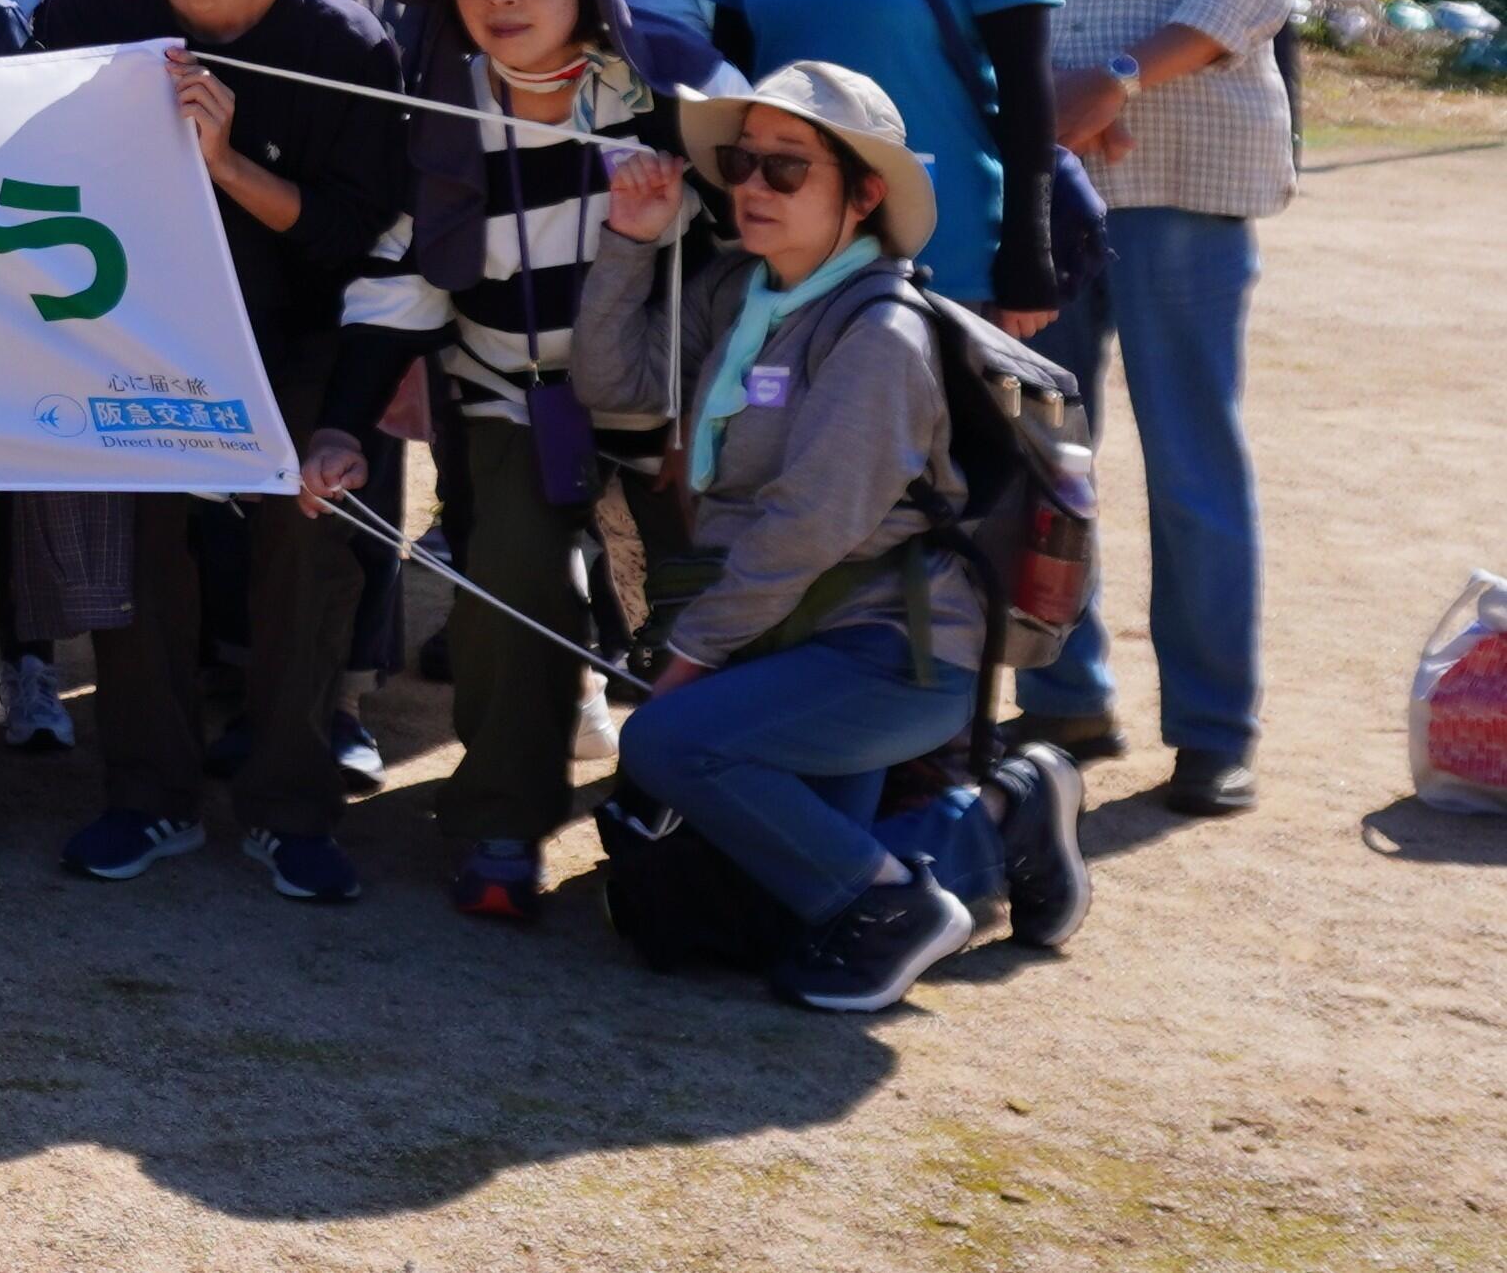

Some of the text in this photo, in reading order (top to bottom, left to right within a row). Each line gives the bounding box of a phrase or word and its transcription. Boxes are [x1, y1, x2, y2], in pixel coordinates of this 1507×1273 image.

[108, 374, 209, 397] 心に届く旅
[94, 400, 247, 431] 阪急交通社
[100, 435, 262, 452] Direct to your heart
